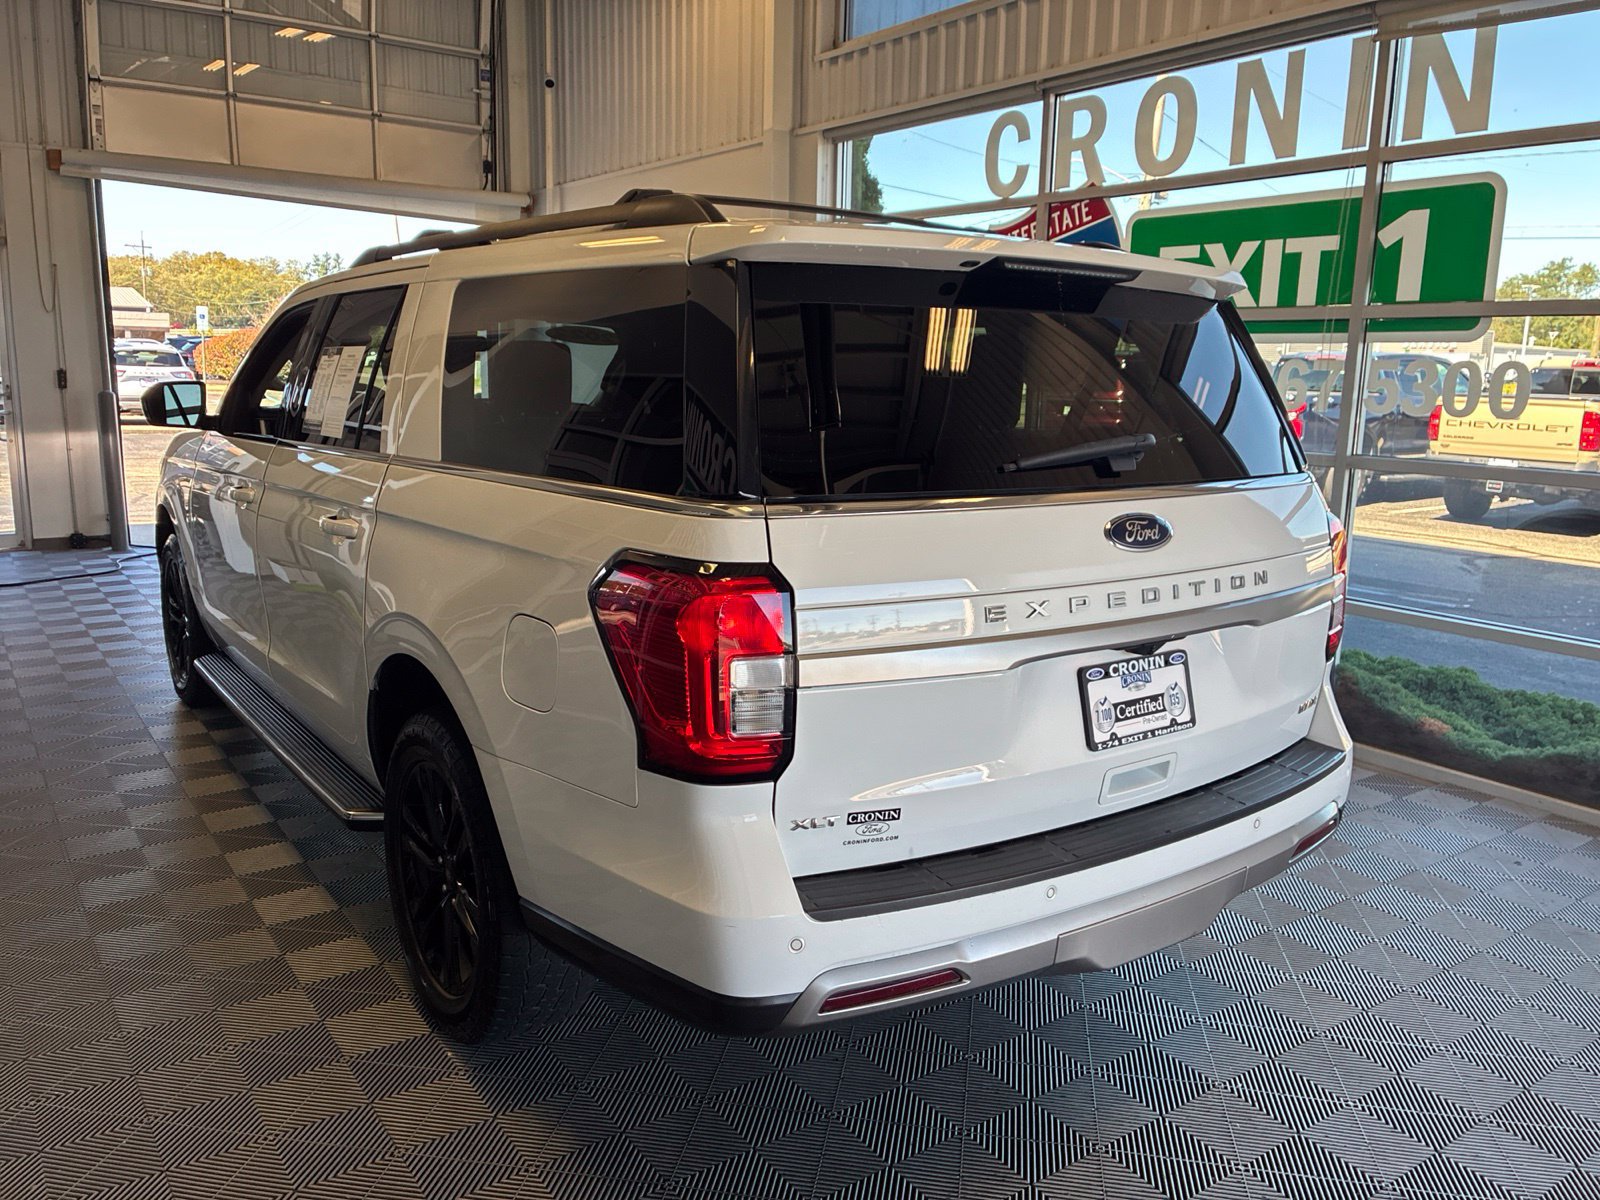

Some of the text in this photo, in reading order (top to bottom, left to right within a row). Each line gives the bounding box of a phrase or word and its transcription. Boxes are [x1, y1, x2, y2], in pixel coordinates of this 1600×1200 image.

[985, 12, 1499, 198] CRONIN
[1377, 208, 1431, 303] 1
[1446, 419, 1575, 434] CHEVROLET
[1125, 519, 1161, 541] Ford
[983, 568, 1270, 624] EXPEDITION
[1109, 655, 1166, 677] CRONIN
[1121, 671, 1152, 687] CRONIN
[1116, 696, 1165, 719] Certified
[1142, 713, 1168, 725] Pre-Owned
[1097, 722, 1193, 750] I-74 EXIT 1 Harrison
[790, 815, 841, 831] XLT
[848, 809, 900, 824] CRONIN
[842, 835, 899, 846] CRONINFORD.COM
